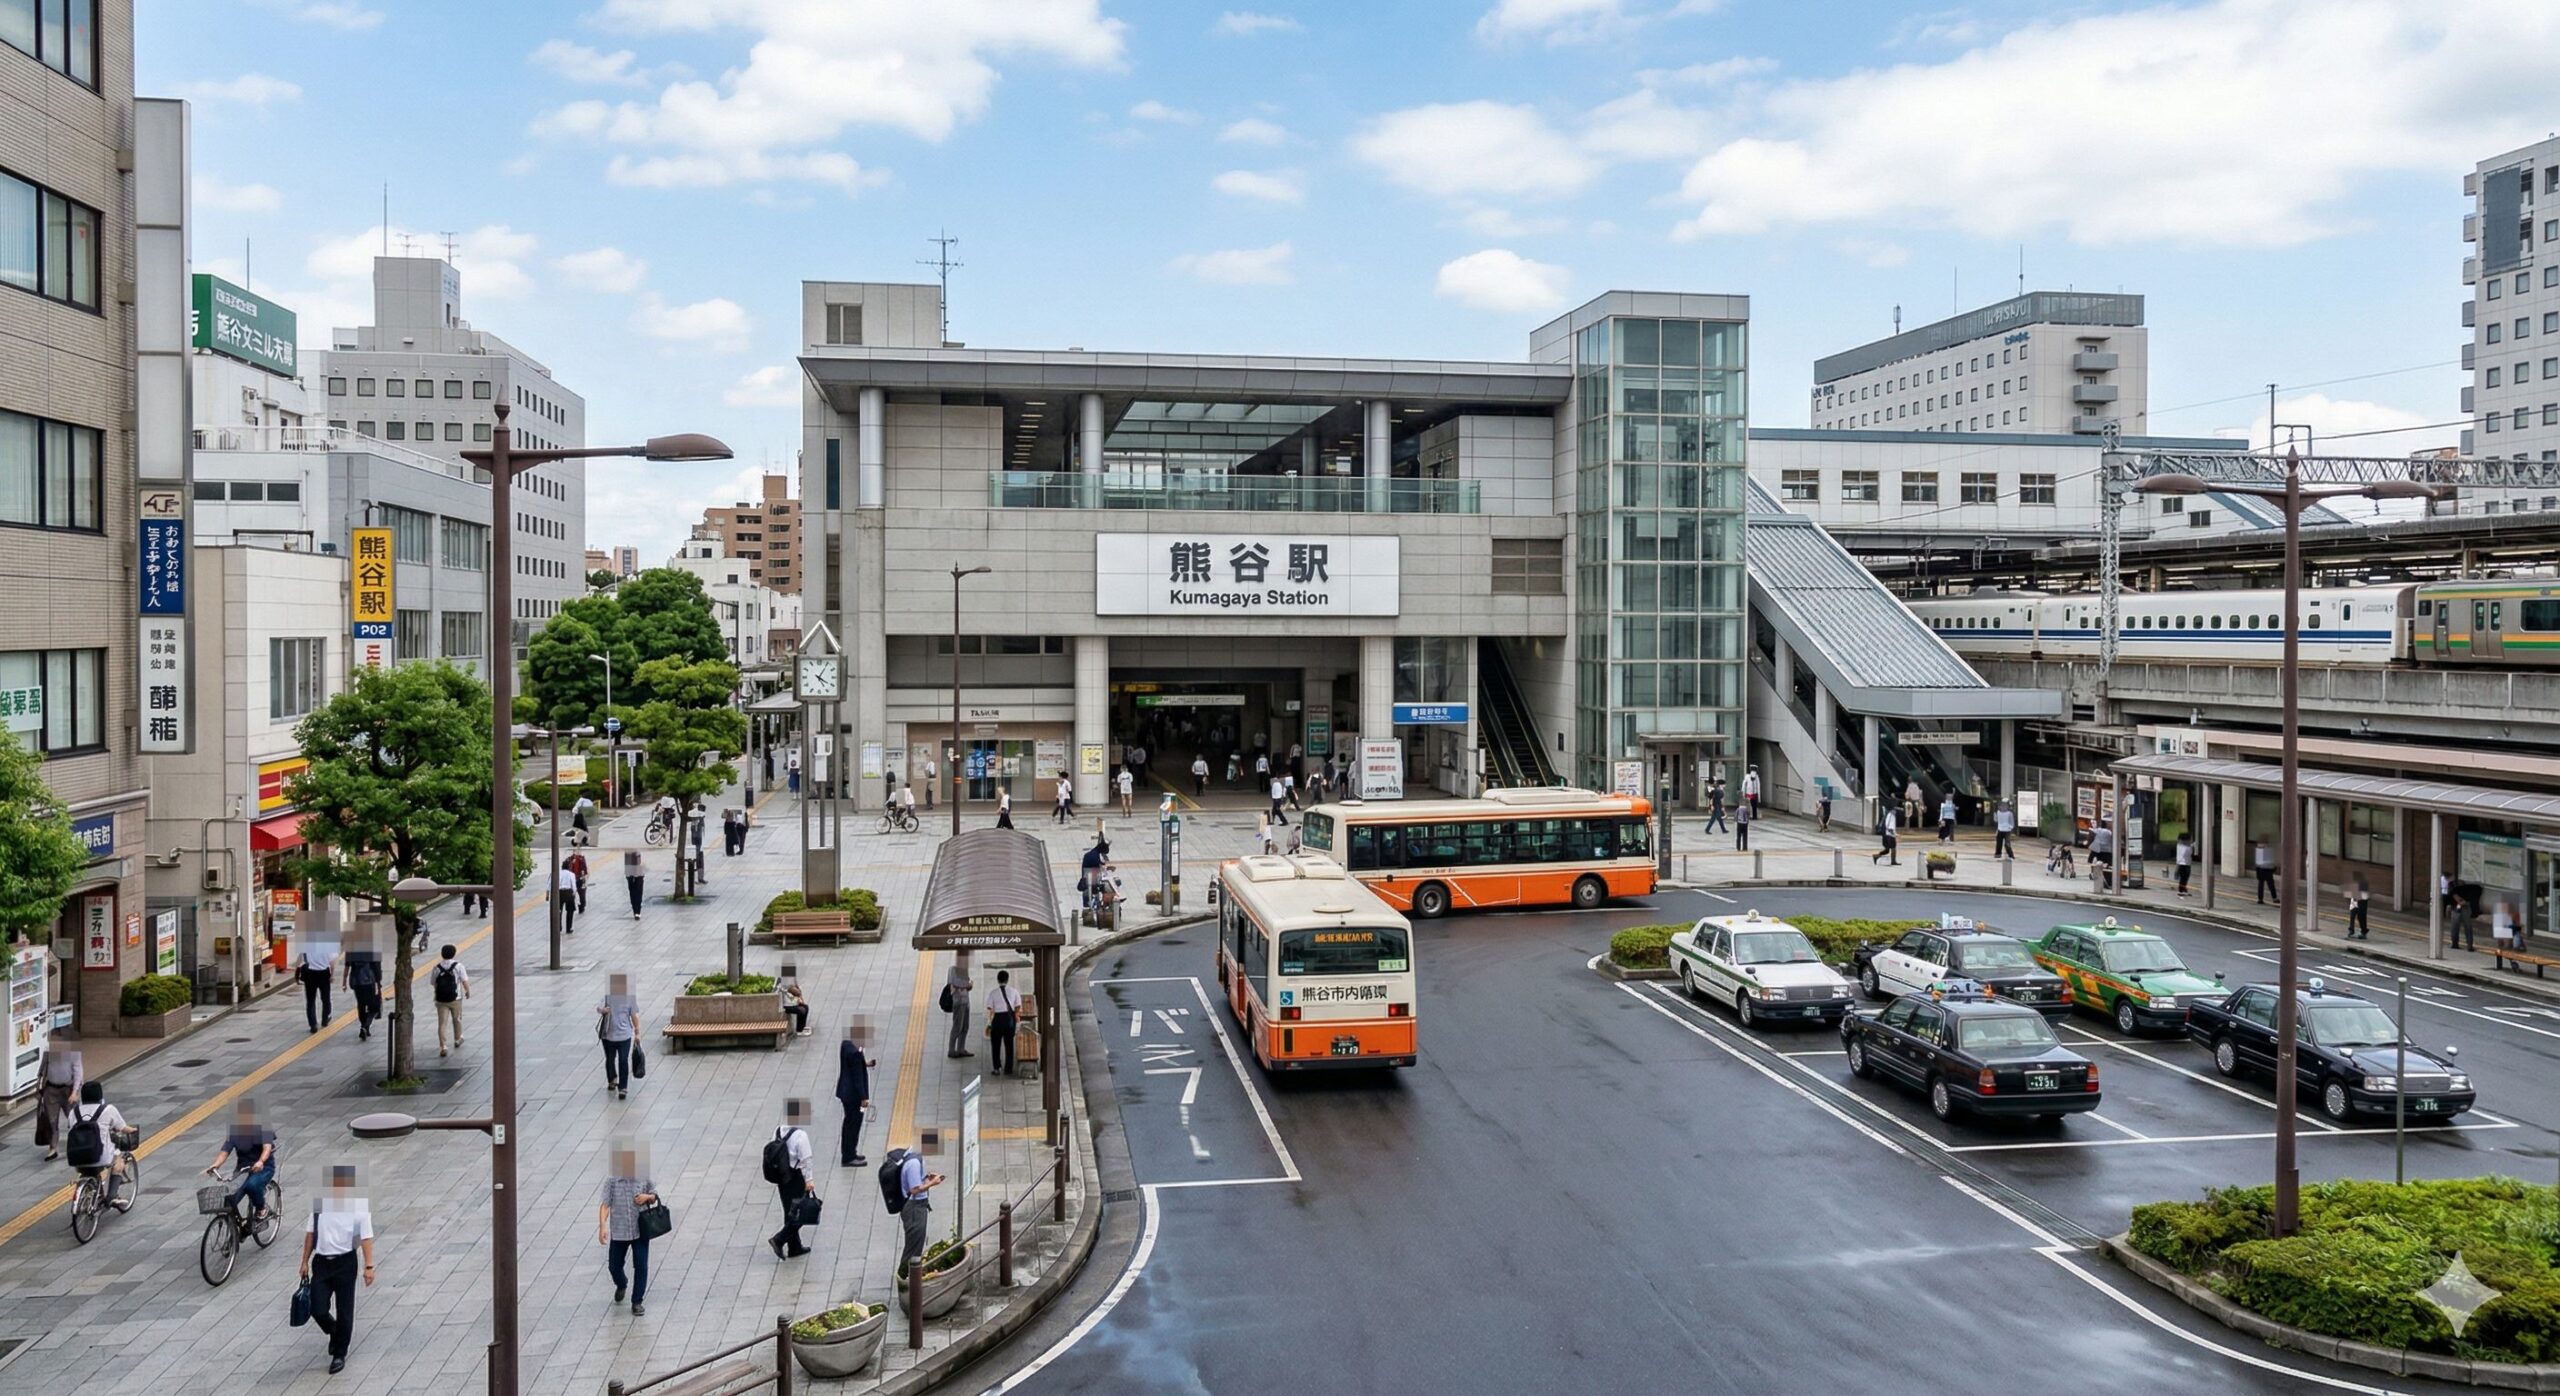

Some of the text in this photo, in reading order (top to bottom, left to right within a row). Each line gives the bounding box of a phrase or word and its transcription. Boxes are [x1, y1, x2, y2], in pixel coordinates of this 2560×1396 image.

[1169, 541, 1329, 584] 熊谷駅
[1170, 589, 1329, 608] Kumagaya Station
